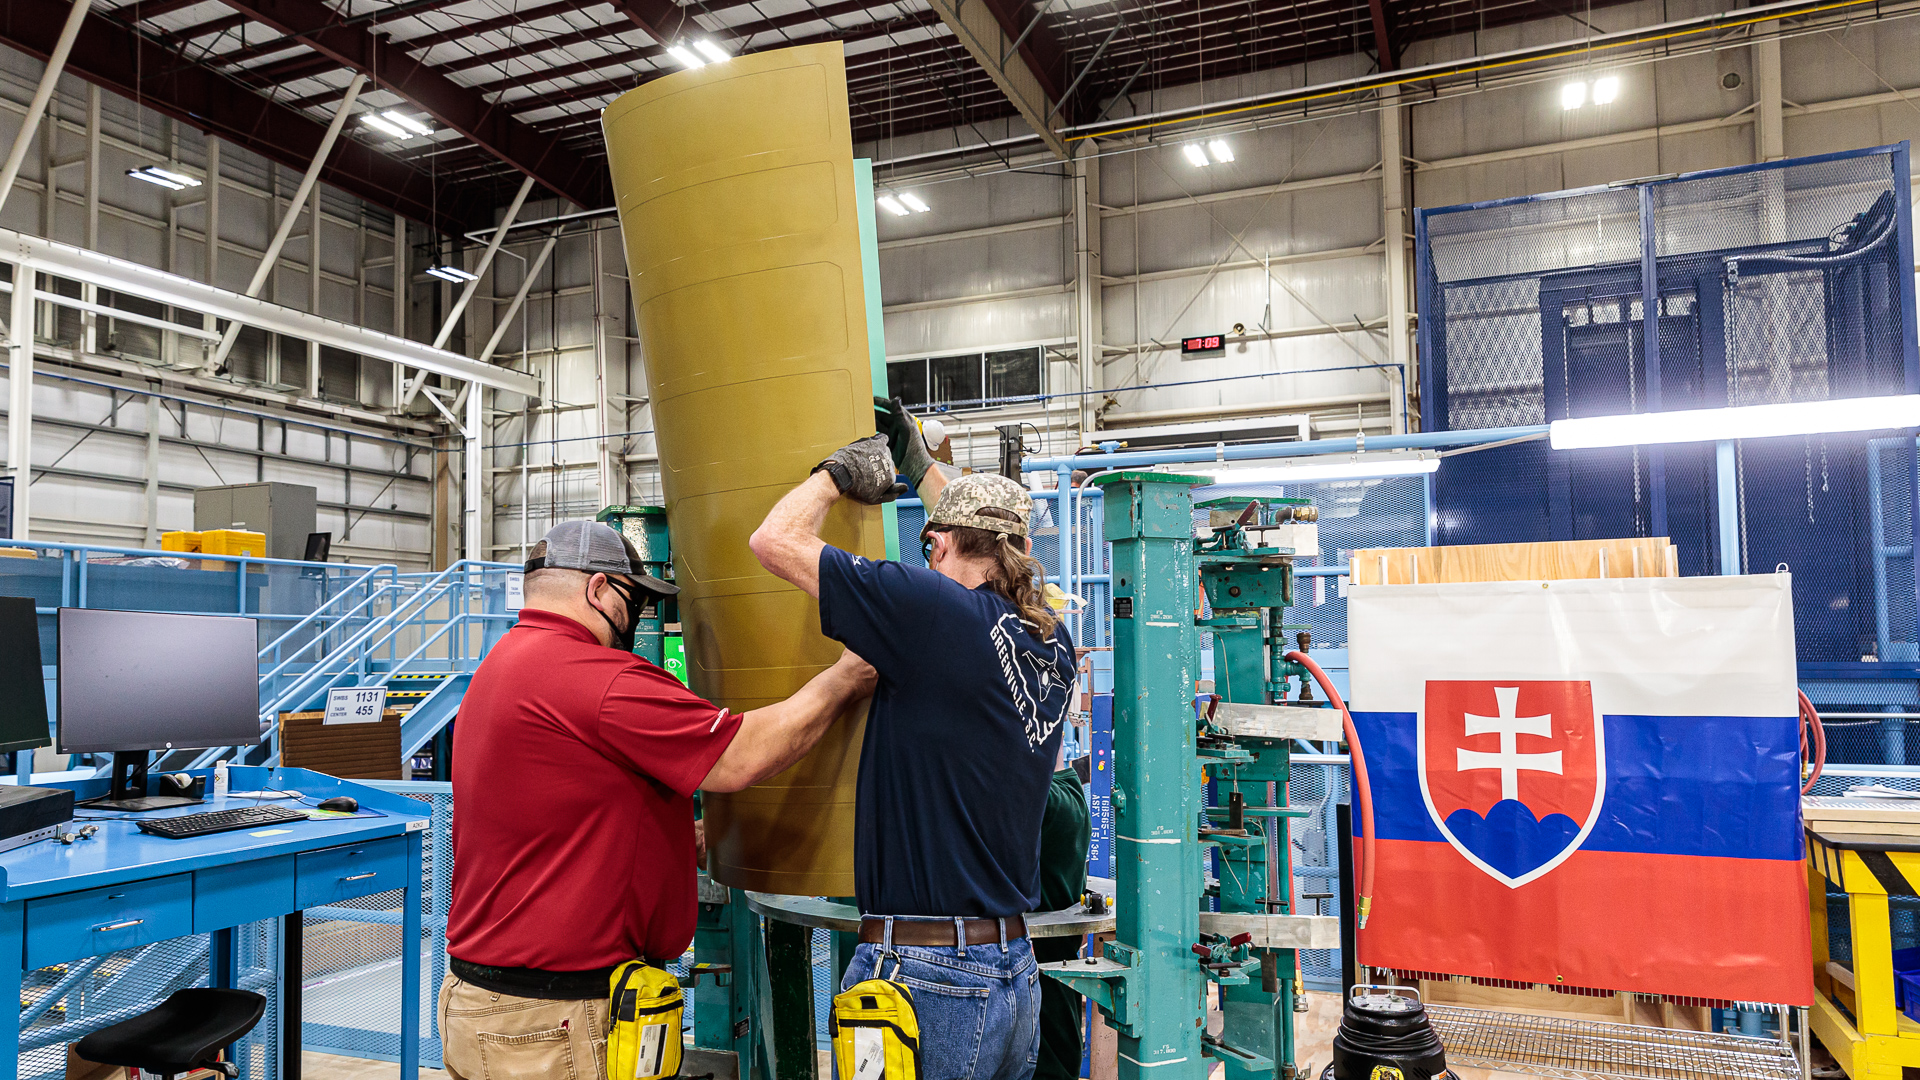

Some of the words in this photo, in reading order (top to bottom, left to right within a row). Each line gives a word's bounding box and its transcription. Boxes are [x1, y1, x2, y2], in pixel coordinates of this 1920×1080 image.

[1195, 337, 1219, 348] 7:09
[355, 691, 379, 703] 1131
[355, 705, 374, 716] 455
[1024, 718, 1036, 753] S.C.
[1091, 794, 1101, 818] ASFX
